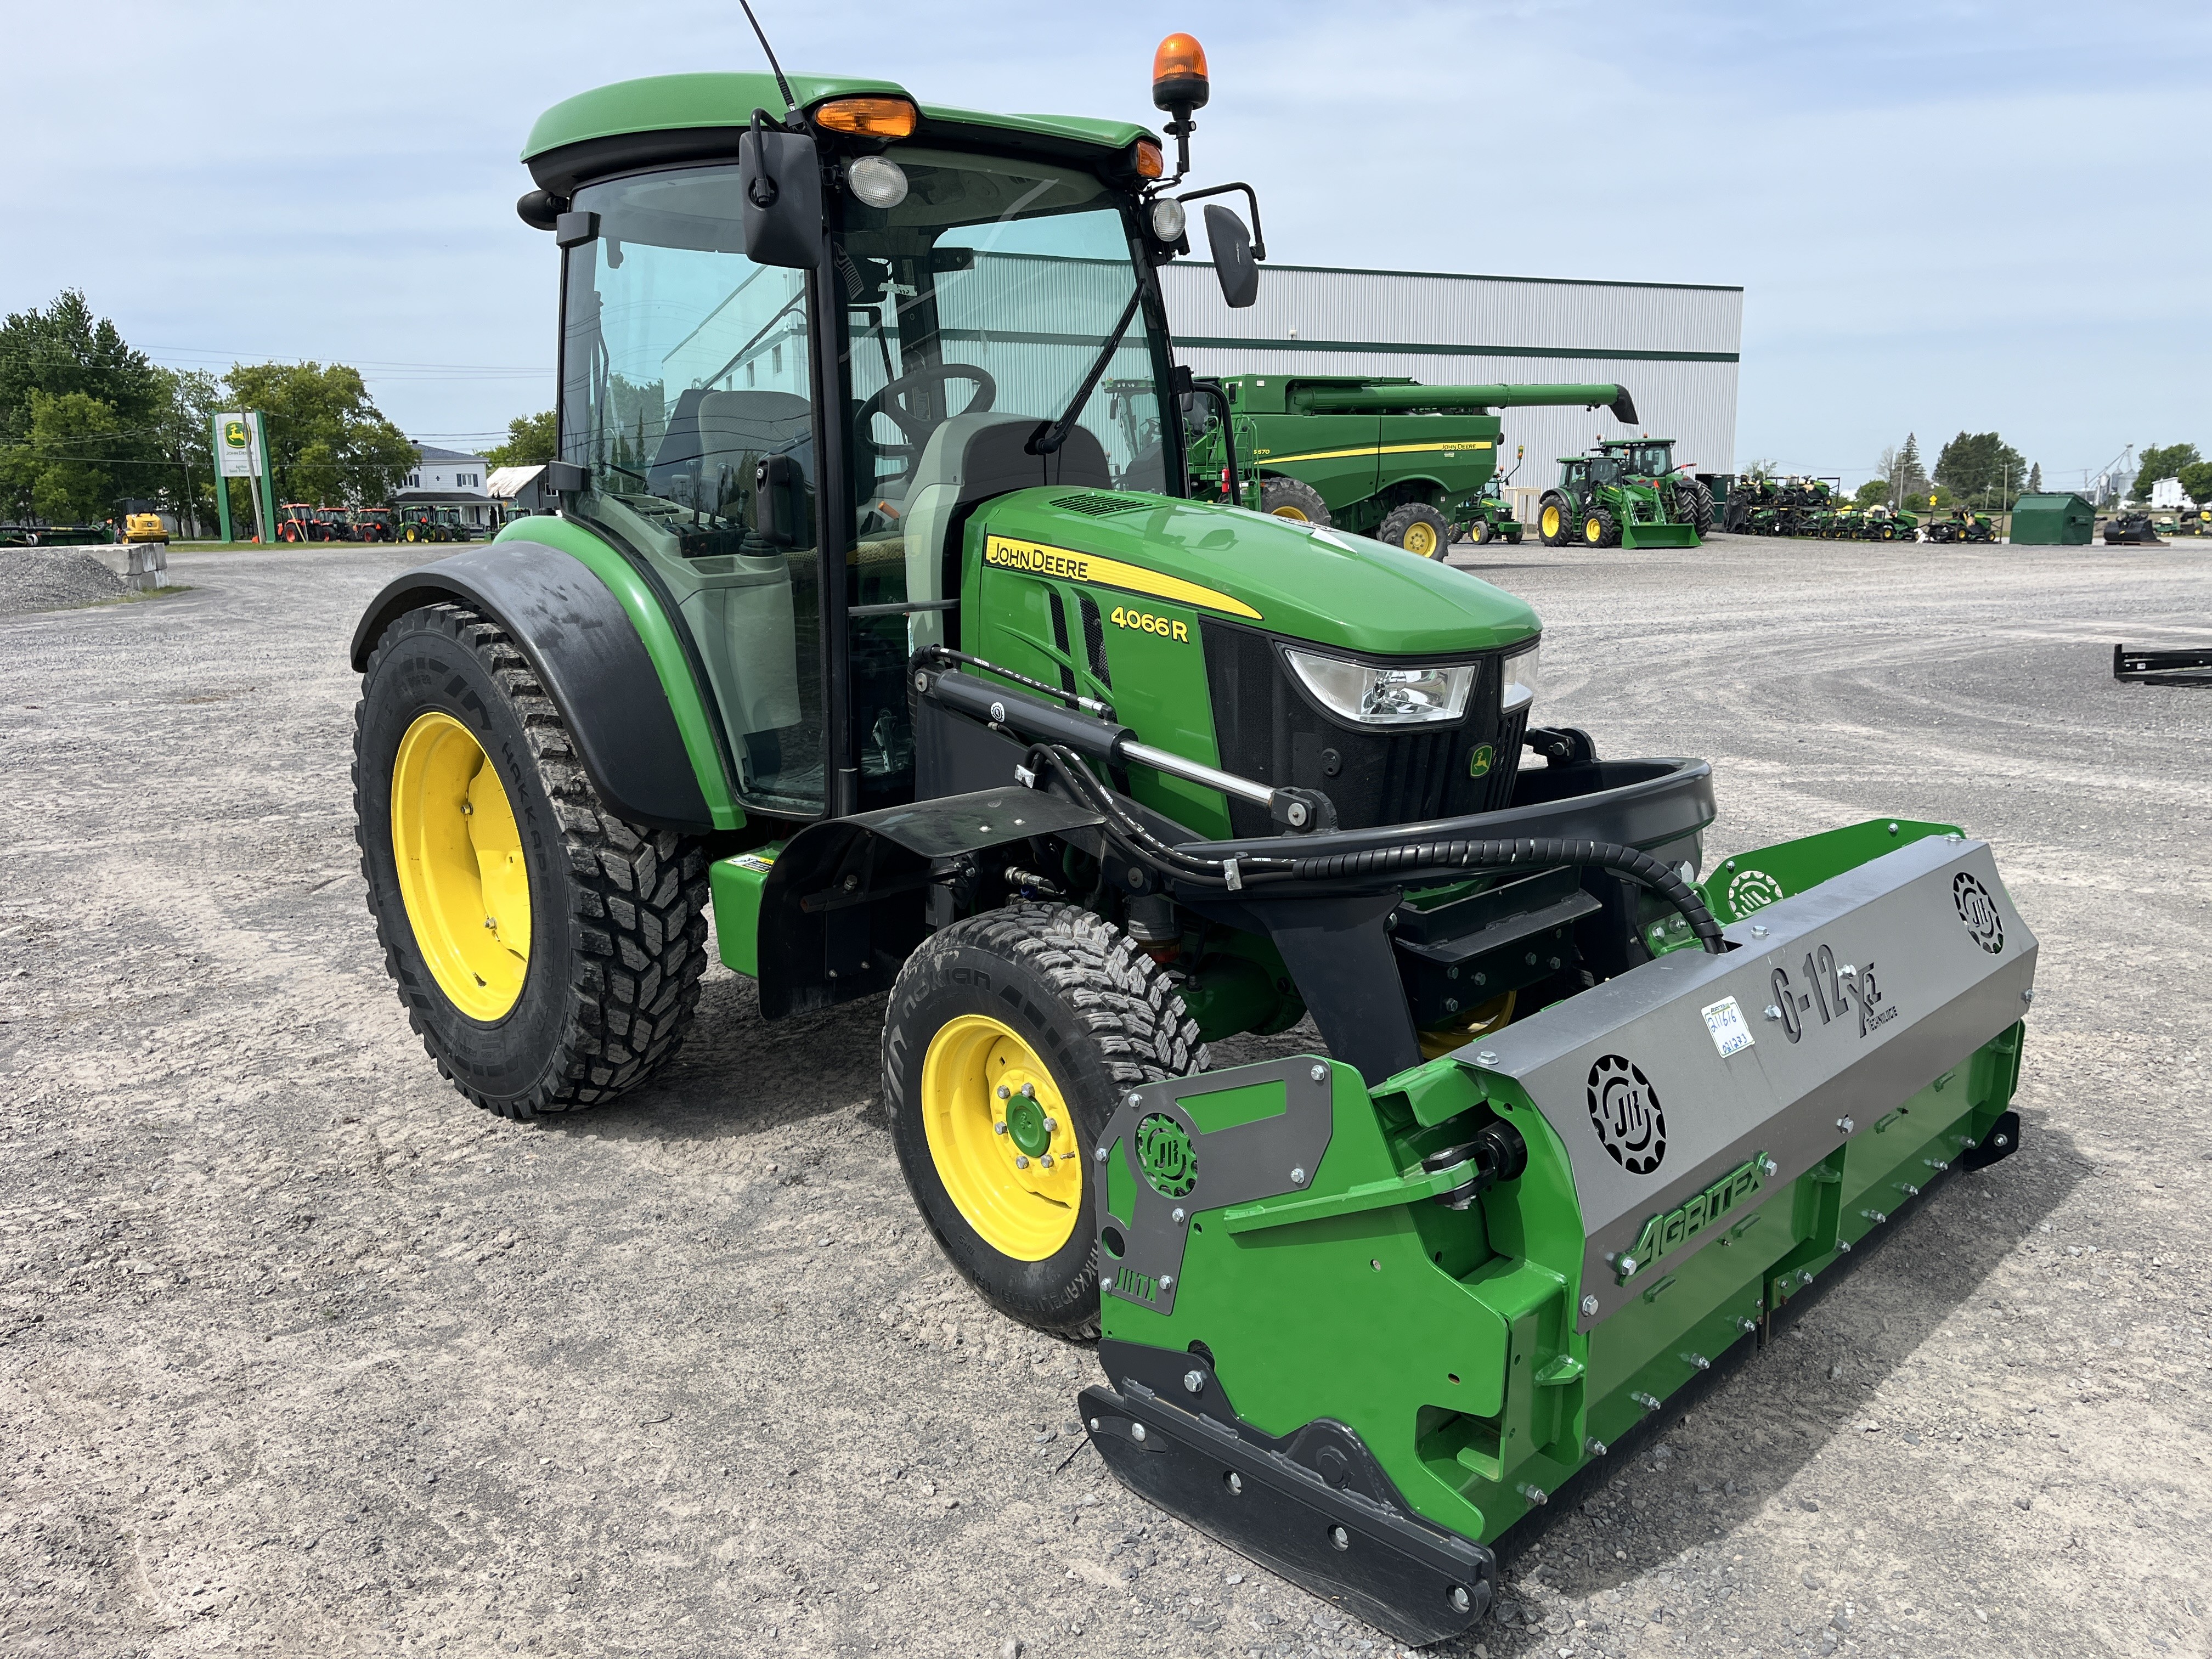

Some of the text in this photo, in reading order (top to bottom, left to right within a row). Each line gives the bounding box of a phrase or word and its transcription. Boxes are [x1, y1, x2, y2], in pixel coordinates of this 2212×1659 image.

[991, 543, 1088, 579] JOHN DEERE
[1110, 605, 1189, 644] 4066R
[1771, 944, 1849, 1043] 6-12
[1708, 1009, 1736, 1032] 211616
[1615, 1090, 1643, 1138] JR
[1620, 1152, 1769, 1287] AGRITEX
